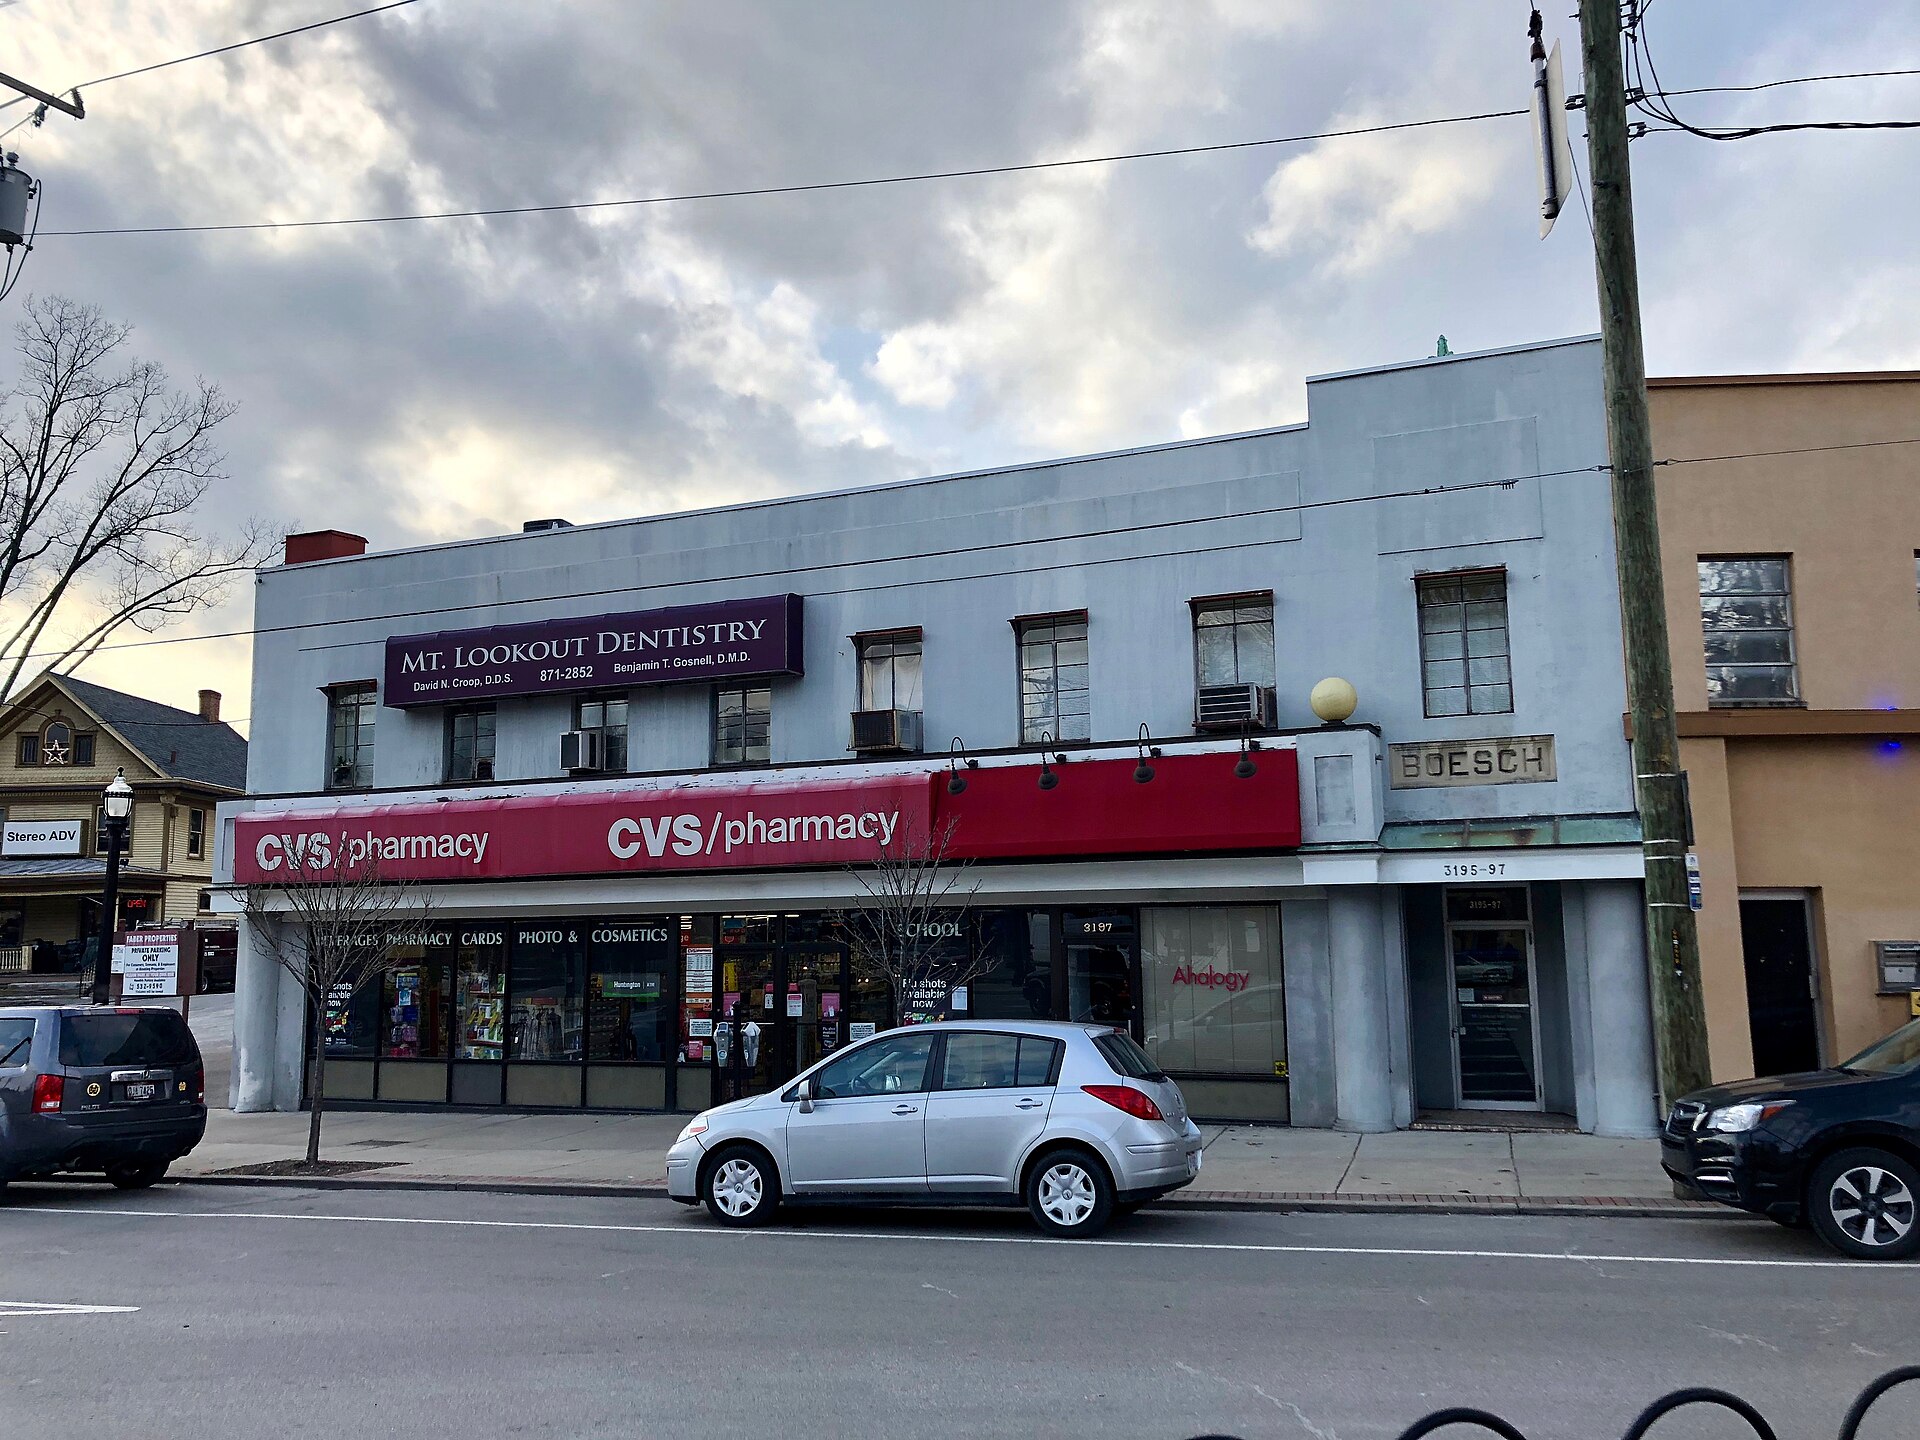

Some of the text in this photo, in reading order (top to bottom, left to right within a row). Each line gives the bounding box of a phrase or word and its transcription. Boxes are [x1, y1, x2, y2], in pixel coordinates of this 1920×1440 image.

[454, 636, 589, 669] LOOKOUT
[597, 618, 768, 655] DENTISTRY
[614, 651, 751, 674] Benjamin T. Gosnell, D.M.D.
[540, 665, 594, 682] 871-2852
[413, 673, 513, 692] David N. Croop, D.D.S.
[1401, 747, 1543, 778] BOESCH
[7, 830, 77, 842] Stereo ADV
[1443, 863, 1506, 877] 3195-97
[127, 899, 147, 908] OPEN
[1083, 922, 1113, 933] 3197
[126, 934, 178, 943] FABER PROPERTIES
[386, 933, 453, 946] PHARMACY
[461, 932, 503, 945] CARDS
[519, 930, 563, 944] PHOTO
[568, 930, 578, 943] &
[591, 928, 668, 943] COSMETICS
[150, 946, 171, 954] PARKING
[142, 954, 160, 962] ONLY
[919, 978, 947, 988] shots
[1172, 964, 1250, 992] Ahalogy
[320, 991, 351, 999] ailble
